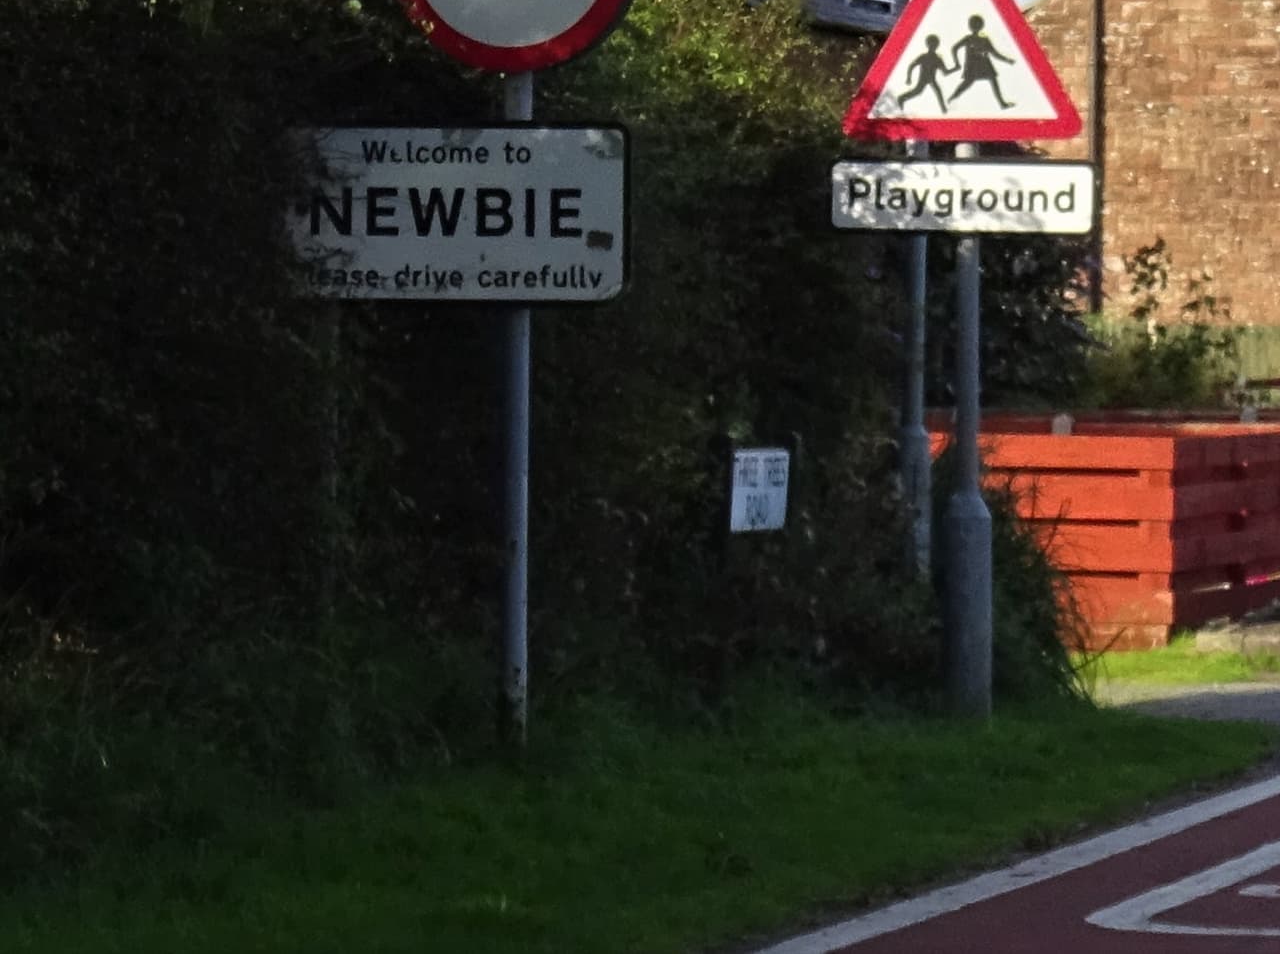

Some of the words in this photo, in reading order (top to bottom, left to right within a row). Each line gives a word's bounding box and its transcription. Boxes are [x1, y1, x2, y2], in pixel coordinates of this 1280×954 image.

[362, 140, 490, 165] Welcome
[504, 141, 532, 165] to
[309, 186, 584, 239] NEWBIE
[848, 177, 1076, 218] Playground
[395, 263, 464, 290] drive
[478, 263, 603, 292] carefully
